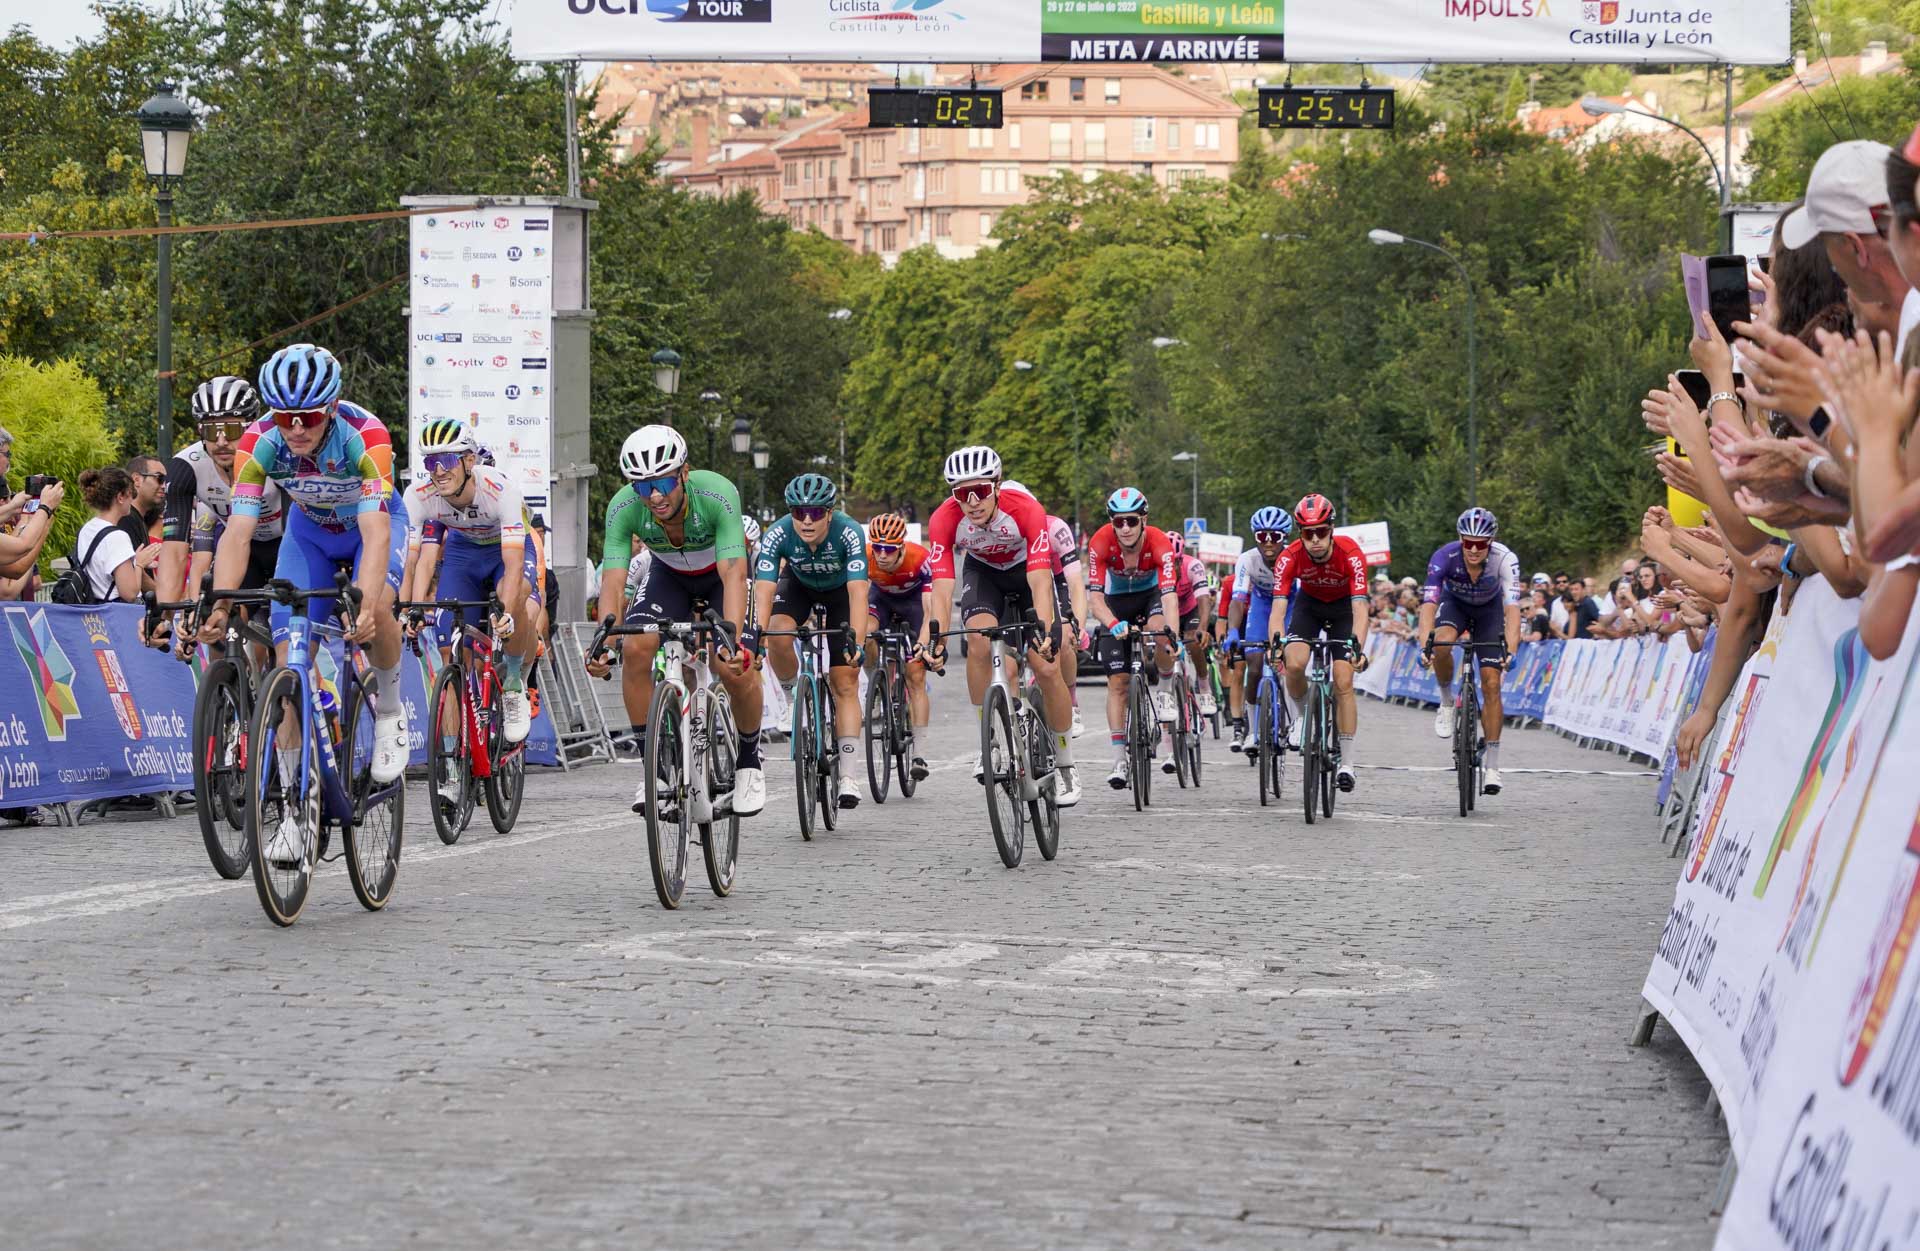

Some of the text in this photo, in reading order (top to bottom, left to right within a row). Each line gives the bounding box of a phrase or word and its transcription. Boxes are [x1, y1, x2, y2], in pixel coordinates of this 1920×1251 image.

[697, 1, 744, 16] TOUR
[829, 0, 880, 12] Ciclista
[1141, 3, 1275, 27] Castilla y León
[1625, 8, 1712, 24] Junta de
[829, 21, 950, 34] Castilla y León
[1569, 29, 1713, 48] Castilla y León
[1070, 40, 1137, 60] META
[1159, 36, 1260, 60] ARRIVÉE
[459, 220, 486, 230] cyltv
[517, 278, 542, 288] Soria
[417, 334, 433, 342] UCI
[458, 359, 484, 368] cyltv
[516, 416, 541, 426] Soria
[296, 480, 362, 494] Jayco
[761, 525, 785, 556] KERN
[842, 526, 862, 556] KERN
[1161, 551, 1174, 579] lotto
[1274, 555, 1291, 591] ARKEA
[1348, 556, 1366, 591] ARKEA
[406, 696, 418, 721] de
[10, 713, 29, 746] de
[141, 708, 188, 738] Junta de
[409, 726, 425, 750] eón
[4, 753, 40, 789] León
[57, 768, 88, 783] CASTILLA
[93, 761, 111, 780] LEÓN
[124, 743, 194, 783] Castilla y León
[1701, 817, 1755, 903] Junta de
[1657, 898, 1695, 971] astilla
[1686, 912, 1721, 993] León
